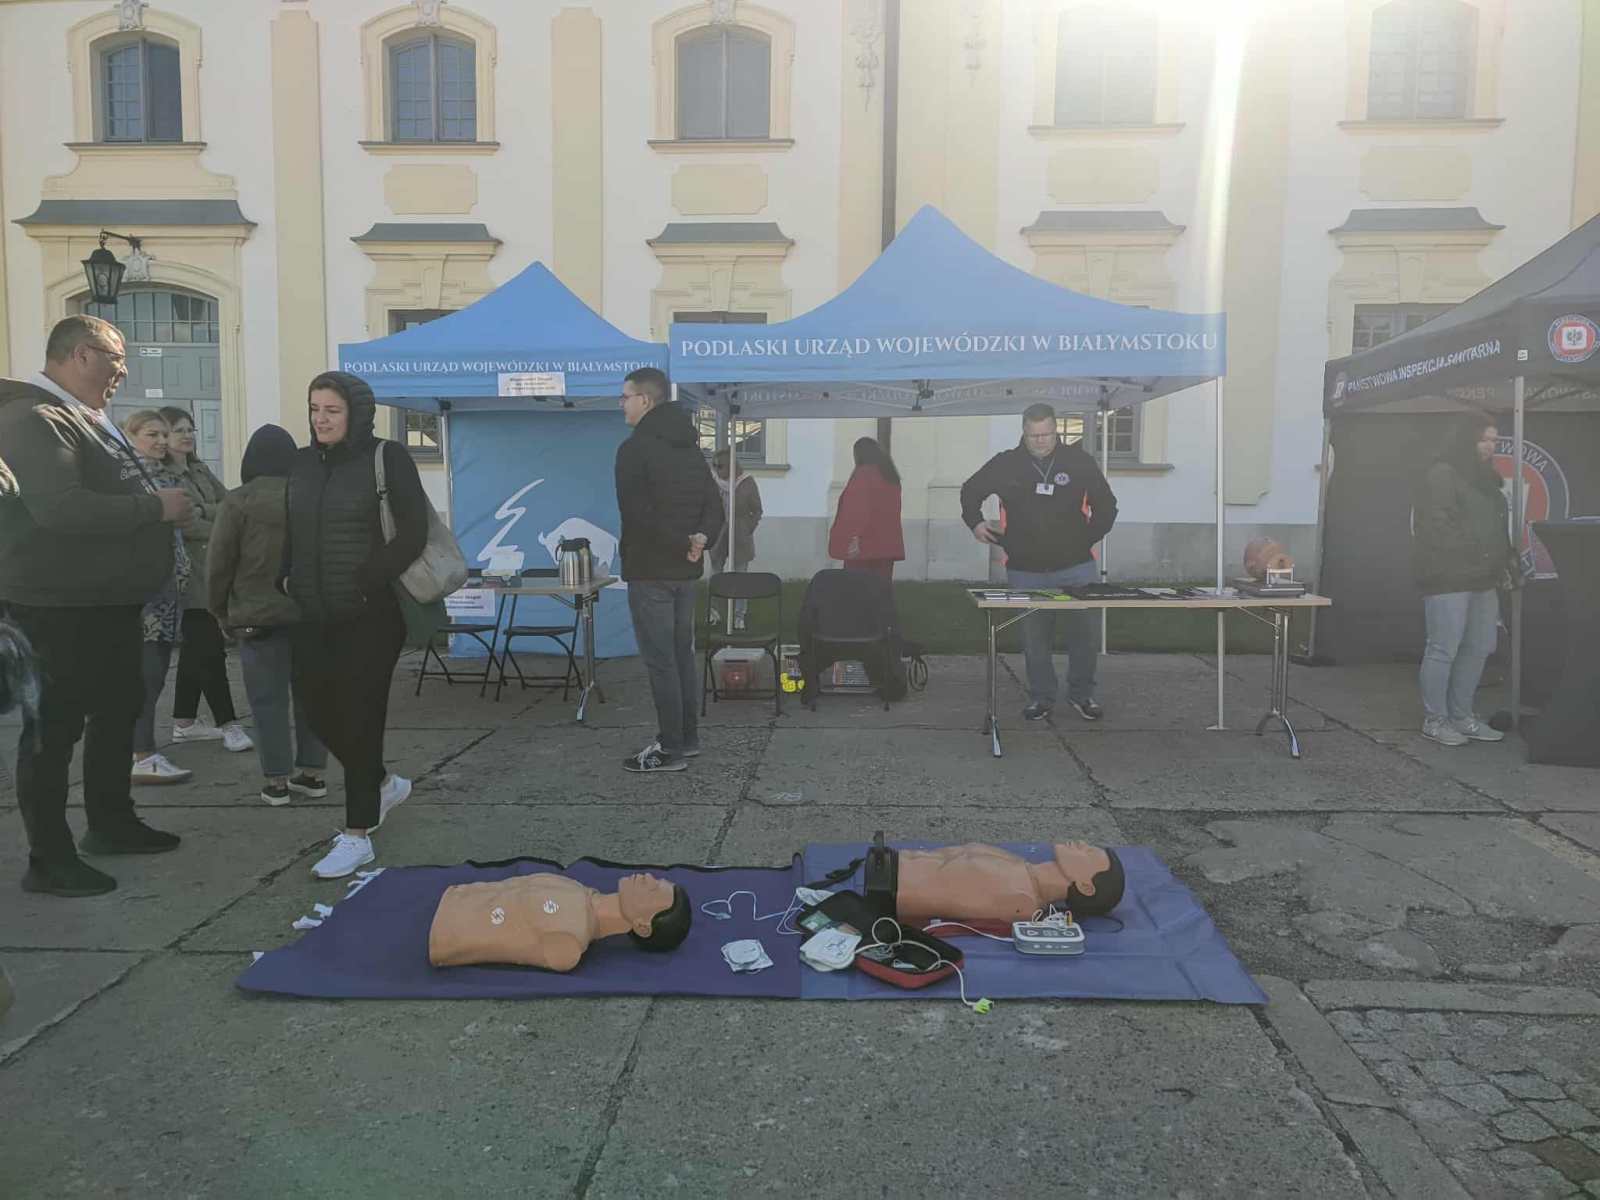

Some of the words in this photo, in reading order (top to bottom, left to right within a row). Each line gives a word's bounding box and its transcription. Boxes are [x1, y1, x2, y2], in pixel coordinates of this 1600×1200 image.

[682, 339, 787, 357] PODLASKI
[795, 338, 870, 358] URZĄD
[876, 331, 1025, 357] WOJEWÓDZKI
[1032, 335, 1051, 351] W
[344, 360, 409, 373] PODLASKI
[413, 361, 459, 375] URZĄD
[462, 358, 549, 374] WOJEWÓDZKI
[552, 360, 565, 372] W
